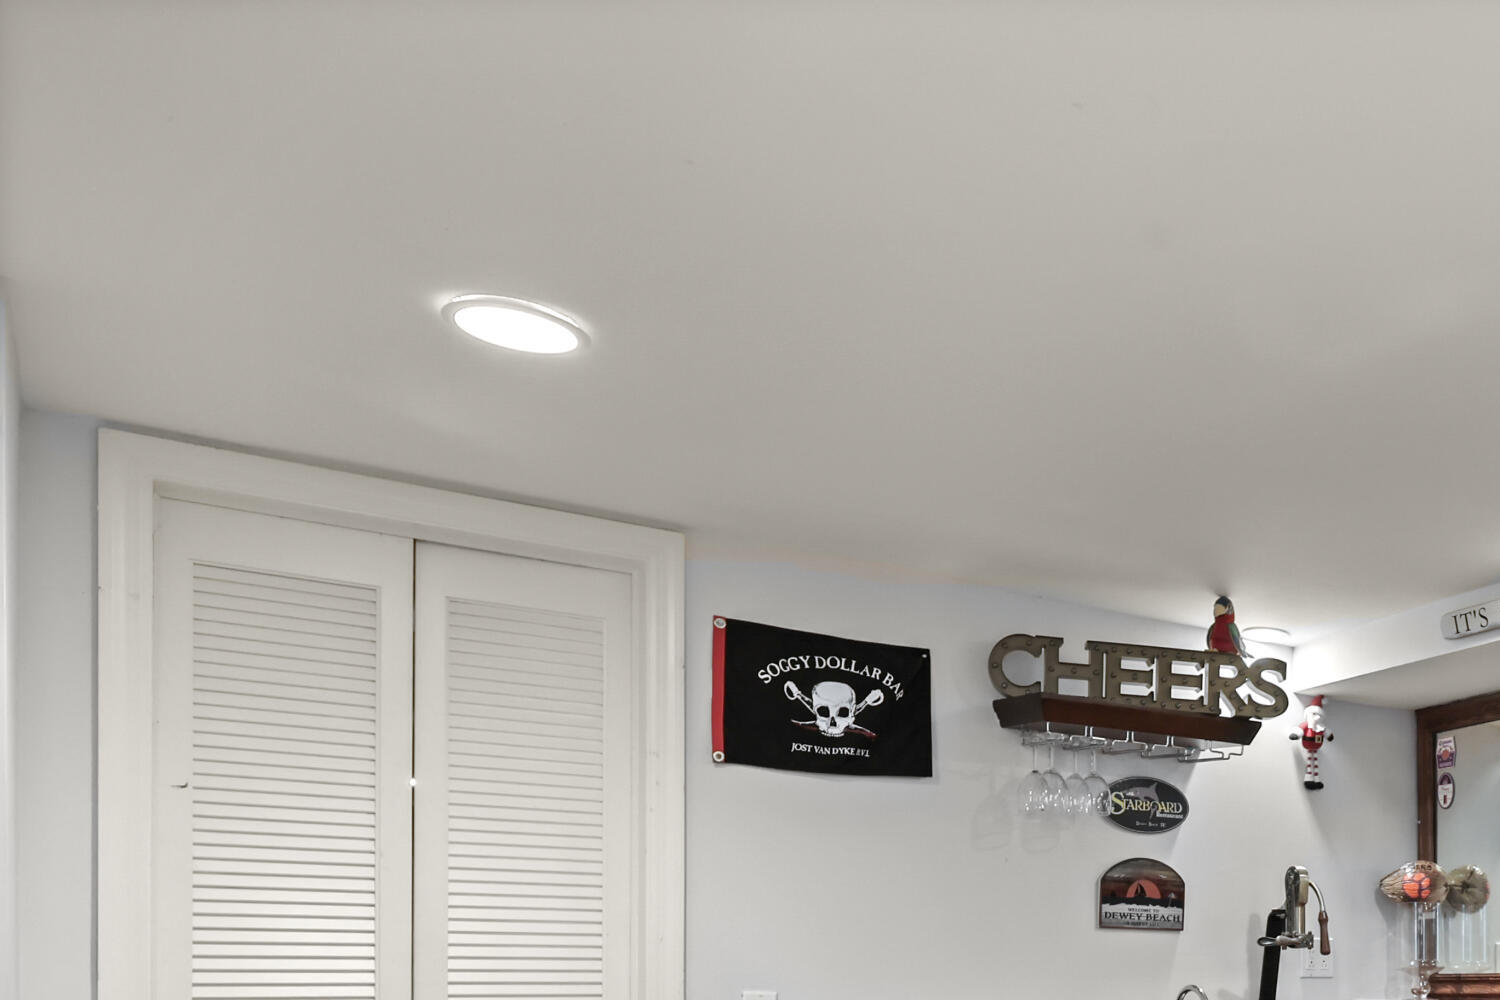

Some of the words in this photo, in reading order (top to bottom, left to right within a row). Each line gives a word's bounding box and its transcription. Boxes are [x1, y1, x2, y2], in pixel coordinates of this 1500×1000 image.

[1452, 607, 1489, 634] IT'S
[757, 655, 811, 684] SOGGY
[814, 654, 882, 680] DOLLAR
[882, 672, 905, 701] BAR
[988, 633, 1289, 720] CHEERS
[791, 742, 813, 752] JOST
[813, 745, 831, 755] VAN
[832, 747, 855, 756] DYKE
[1111, 791, 1183, 815] STARBOARD
[1104, 911, 1143, 920] DEWEY
[1146, 913, 1181, 923] BEACH
